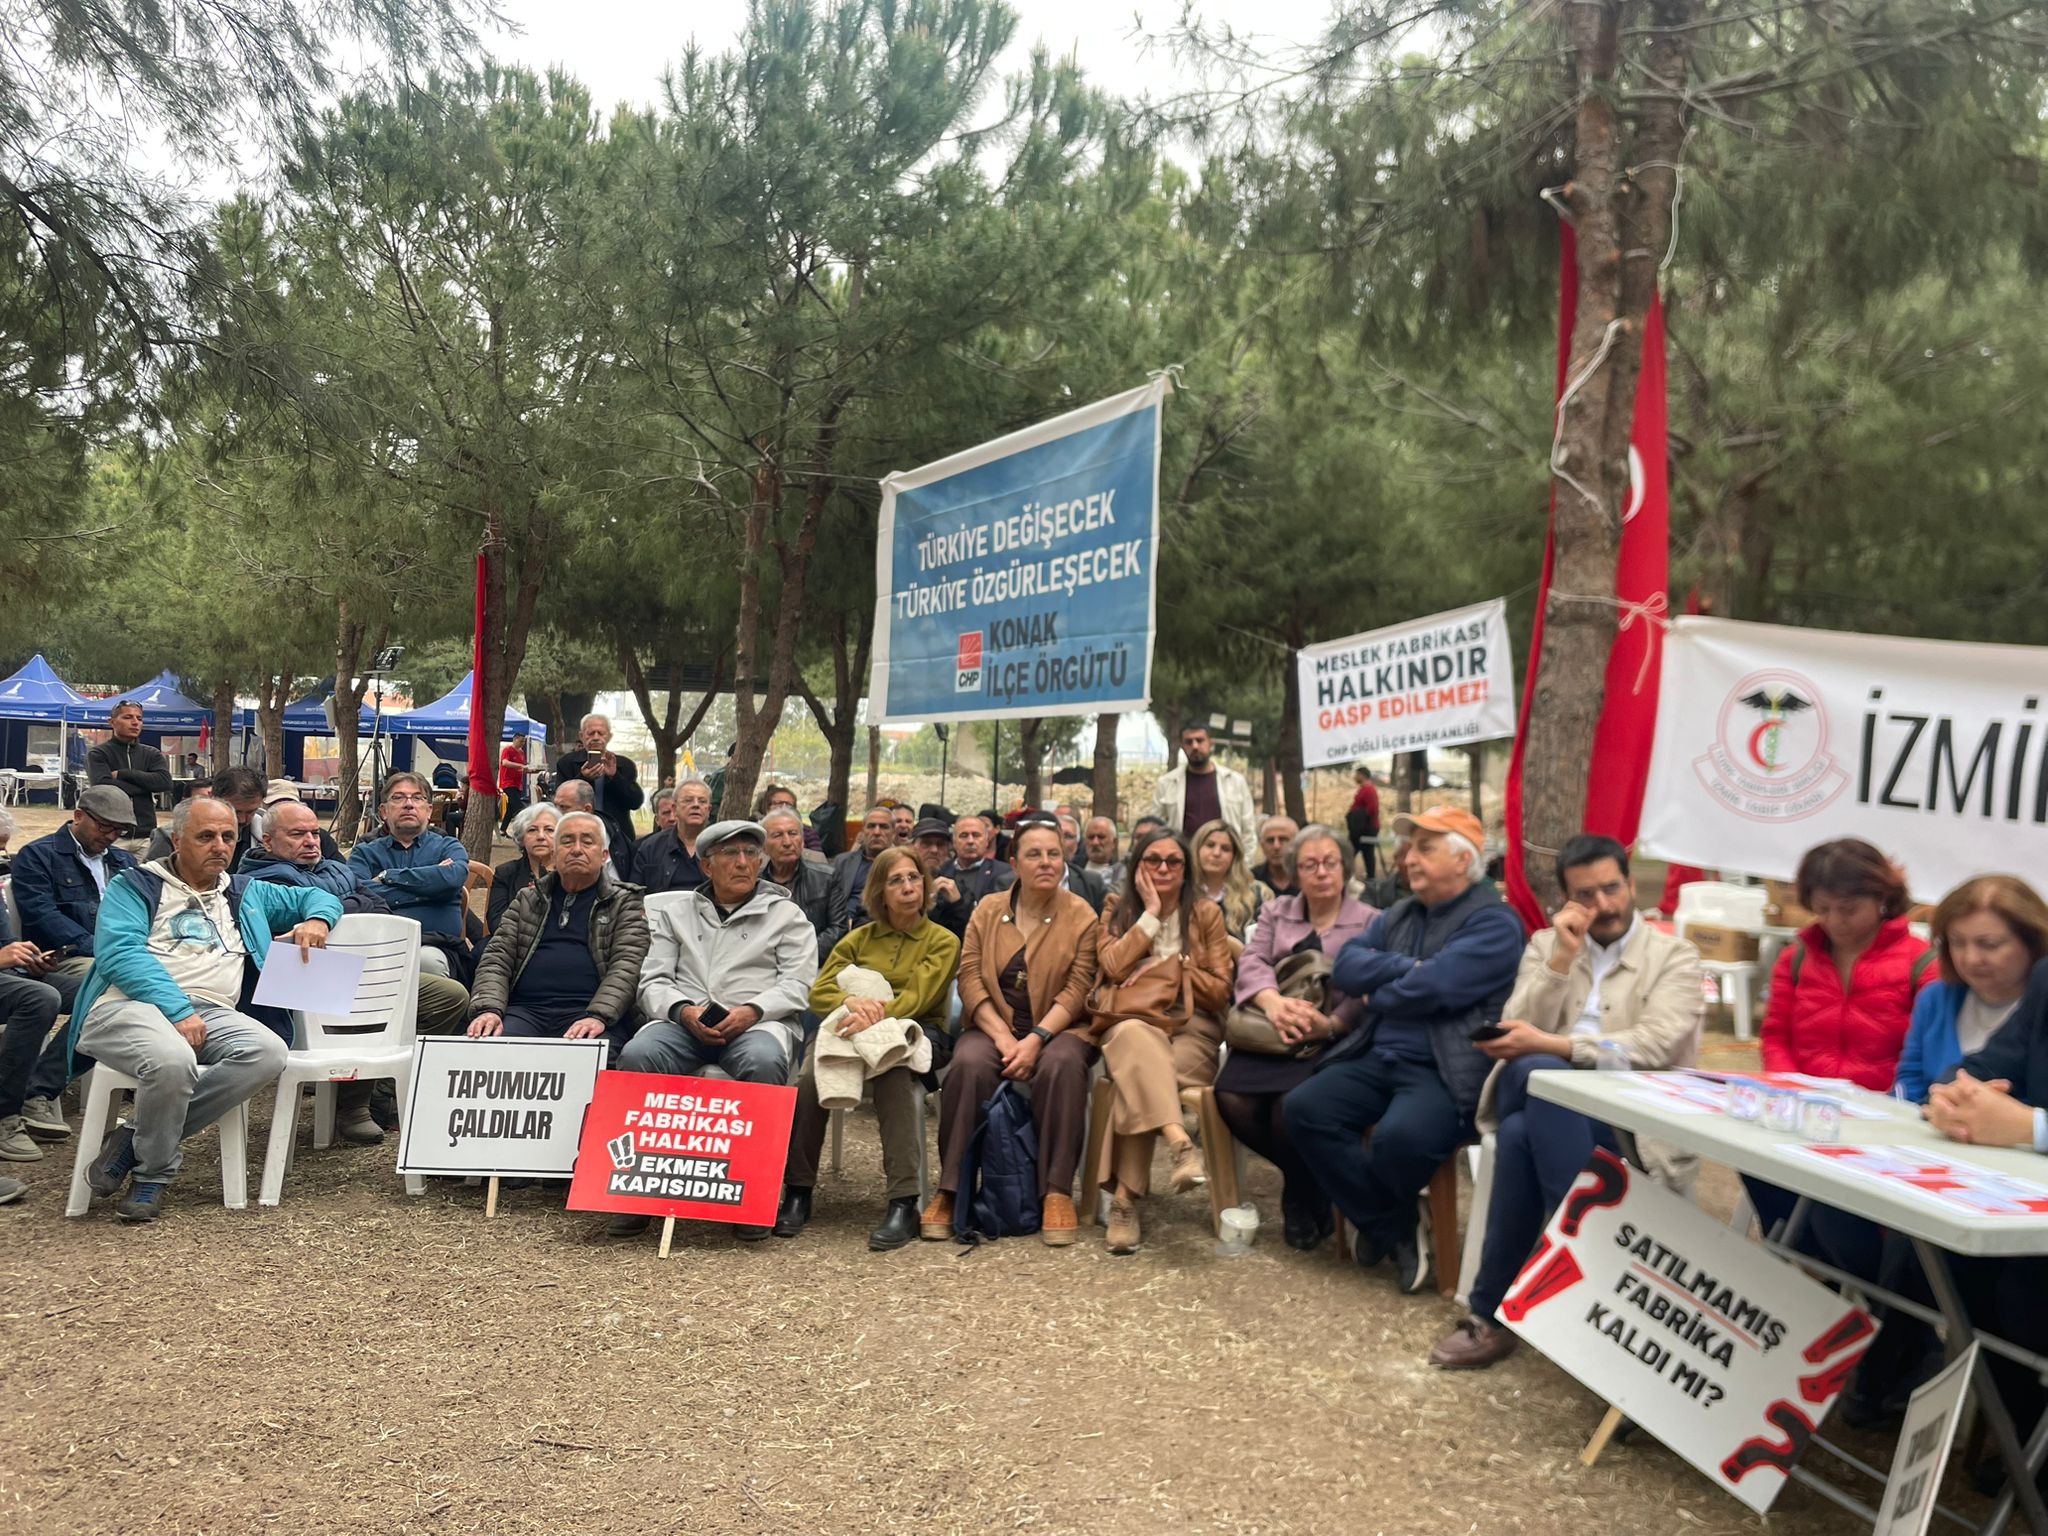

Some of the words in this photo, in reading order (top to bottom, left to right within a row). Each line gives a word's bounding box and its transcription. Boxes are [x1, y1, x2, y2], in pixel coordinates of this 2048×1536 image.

[919, 525, 988, 572] TÜRKİYE
[993, 489, 1116, 550] DEĞİŞECEK
[897, 577, 966, 620] TÜRKİYE
[972, 540, 1142, 606] ÖZGÜRLEŞECEK
[989, 611, 1058, 651] KONAK
[1317, 647, 1382, 674] MESLEK
[1388, 620, 1487, 656] FABRİKASI
[958, 672, 980, 688] CHP
[986, 662, 1029, 705] İLÇE
[1035, 643, 1128, 693] ÖRGÜTÜ
[1318, 647, 1487, 706] HALKINDIR
[1319, 704, 1372, 731] GASP
[1379, 680, 1489, 720] EDİLEMEZ!
[1327, 745, 1348, 758] CHP
[1382, 734, 1406, 750] İLÇE
[1857, 688, 2048, 823] İZMİ
[448, 1070, 566, 1101] TAPUMUZU
[644, 1092, 742, 1116] MESLEK
[448, 1109, 553, 1148] ÇALDILAR
[624, 1111, 753, 1136] FABRİKASI
[639, 1130, 731, 1154] HALKIN
[610, 1174, 743, 1201] KAPISIDIR!
[640, 1157, 728, 1179] EKMEK
[1615, 1223, 1787, 1356] SATILMAMIŞ
[1614, 1270, 1735, 1368] FABRİKA
[1585, 1303, 1672, 1374] KALDI
[1669, 1361, 1725, 1408] MI?
